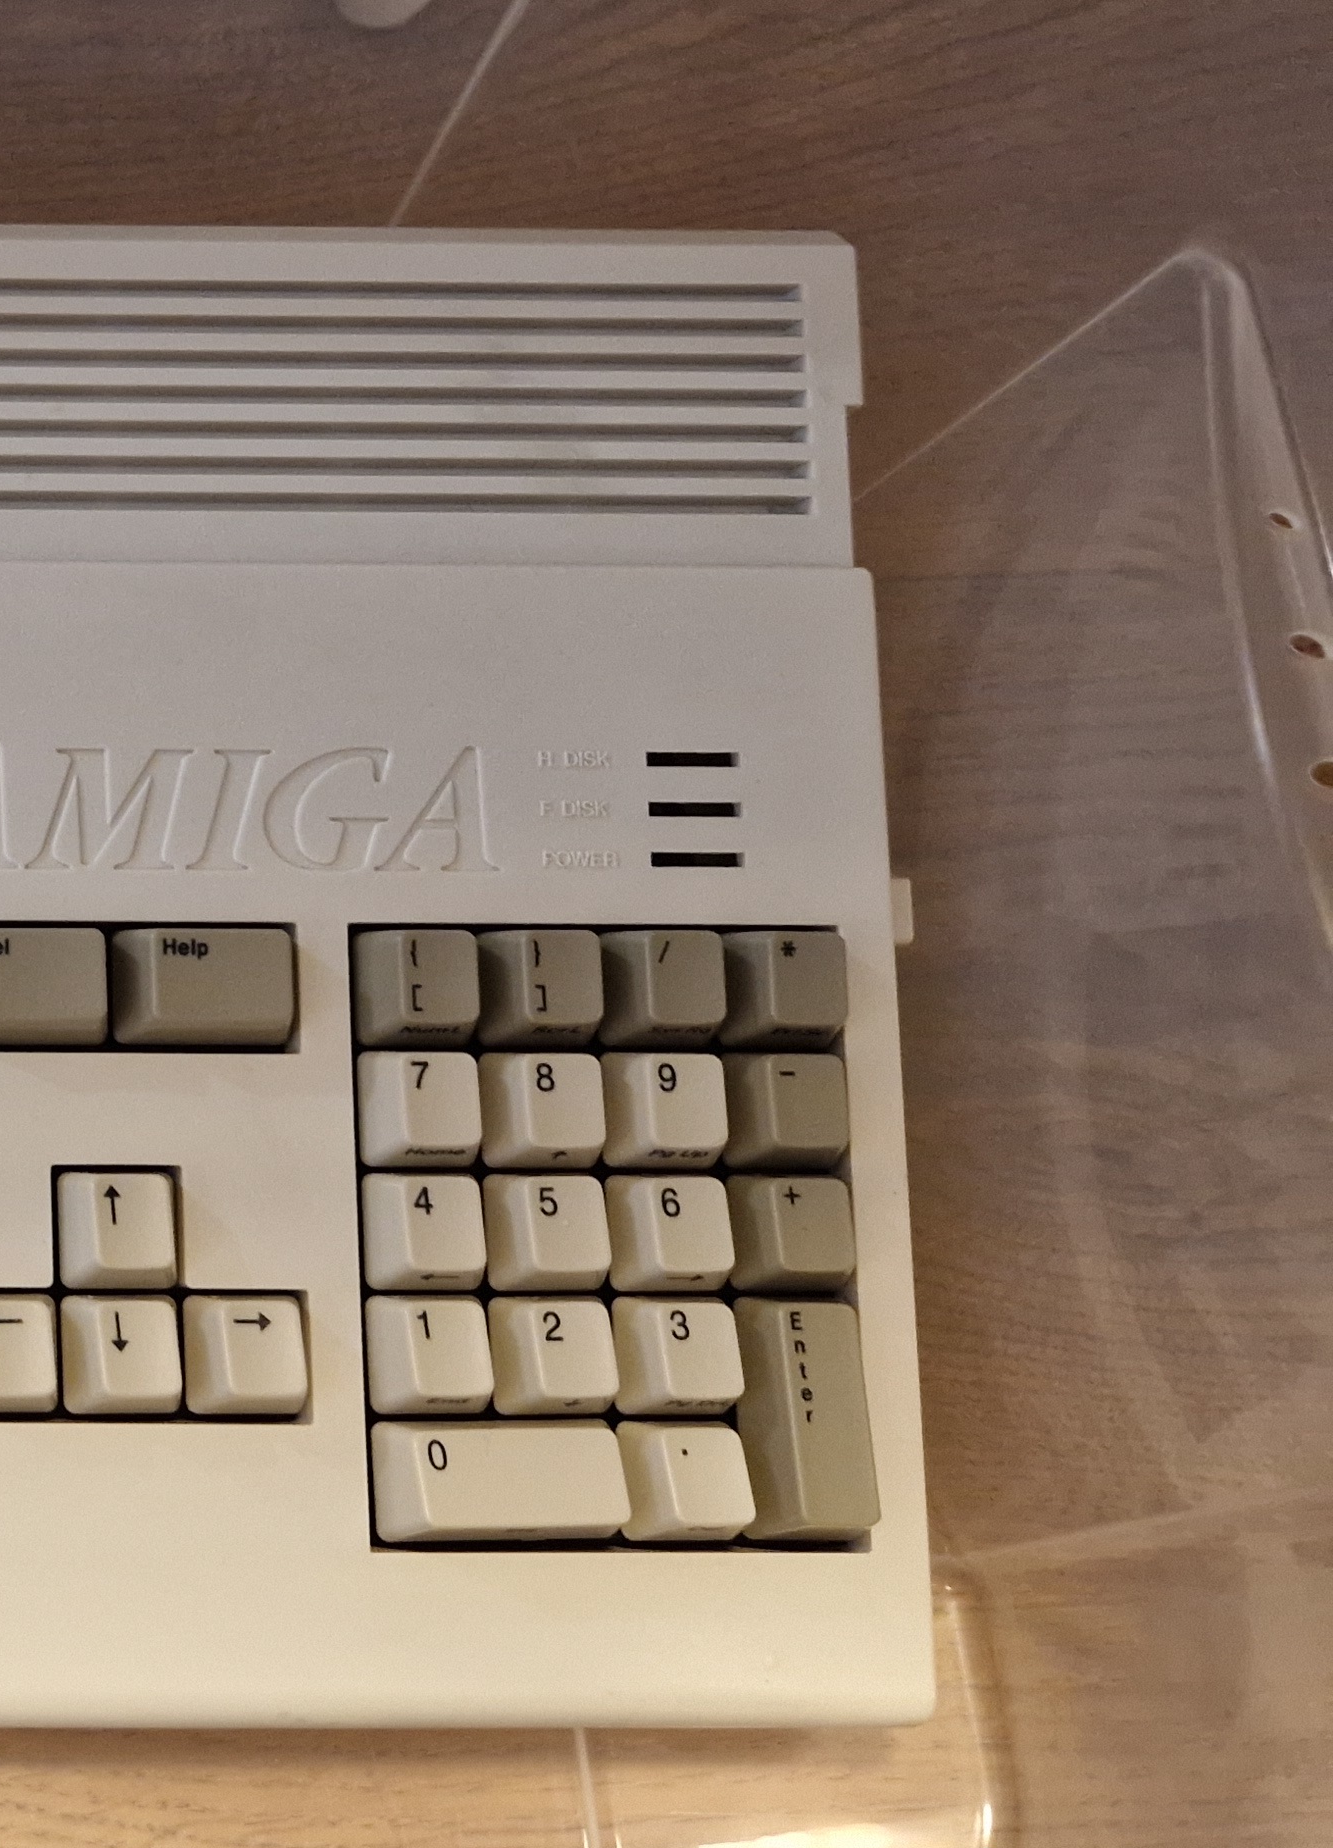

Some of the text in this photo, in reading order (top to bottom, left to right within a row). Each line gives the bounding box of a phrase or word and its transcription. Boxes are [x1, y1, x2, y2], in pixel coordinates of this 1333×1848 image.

[564, 751, 611, 767] DISK
[562, 801, 608, 817] DISK
[163, 938, 208, 959] Help
[658, 941, 670, 963] /
[412, 984, 423, 1012] [
[535, 984, 547, 1012] ]
[411, 1061, 429, 1089] 7
[536, 1063, 555, 1092] 8
[658, 1063, 676, 1092] 9
[414, 1187, 433, 1214] 4
[540, 1187, 558, 1216] 5
[661, 1188, 680, 1217] 6
[784, 1186, 800, 1205] +
[418, 1311, 430, 1339] 1
[543, 1312, 563, 1341] 2
[670, 1310, 689, 1340] 3
[790, 1311, 812, 1422] Enter
[428, 1440, 447, 1470] 0
